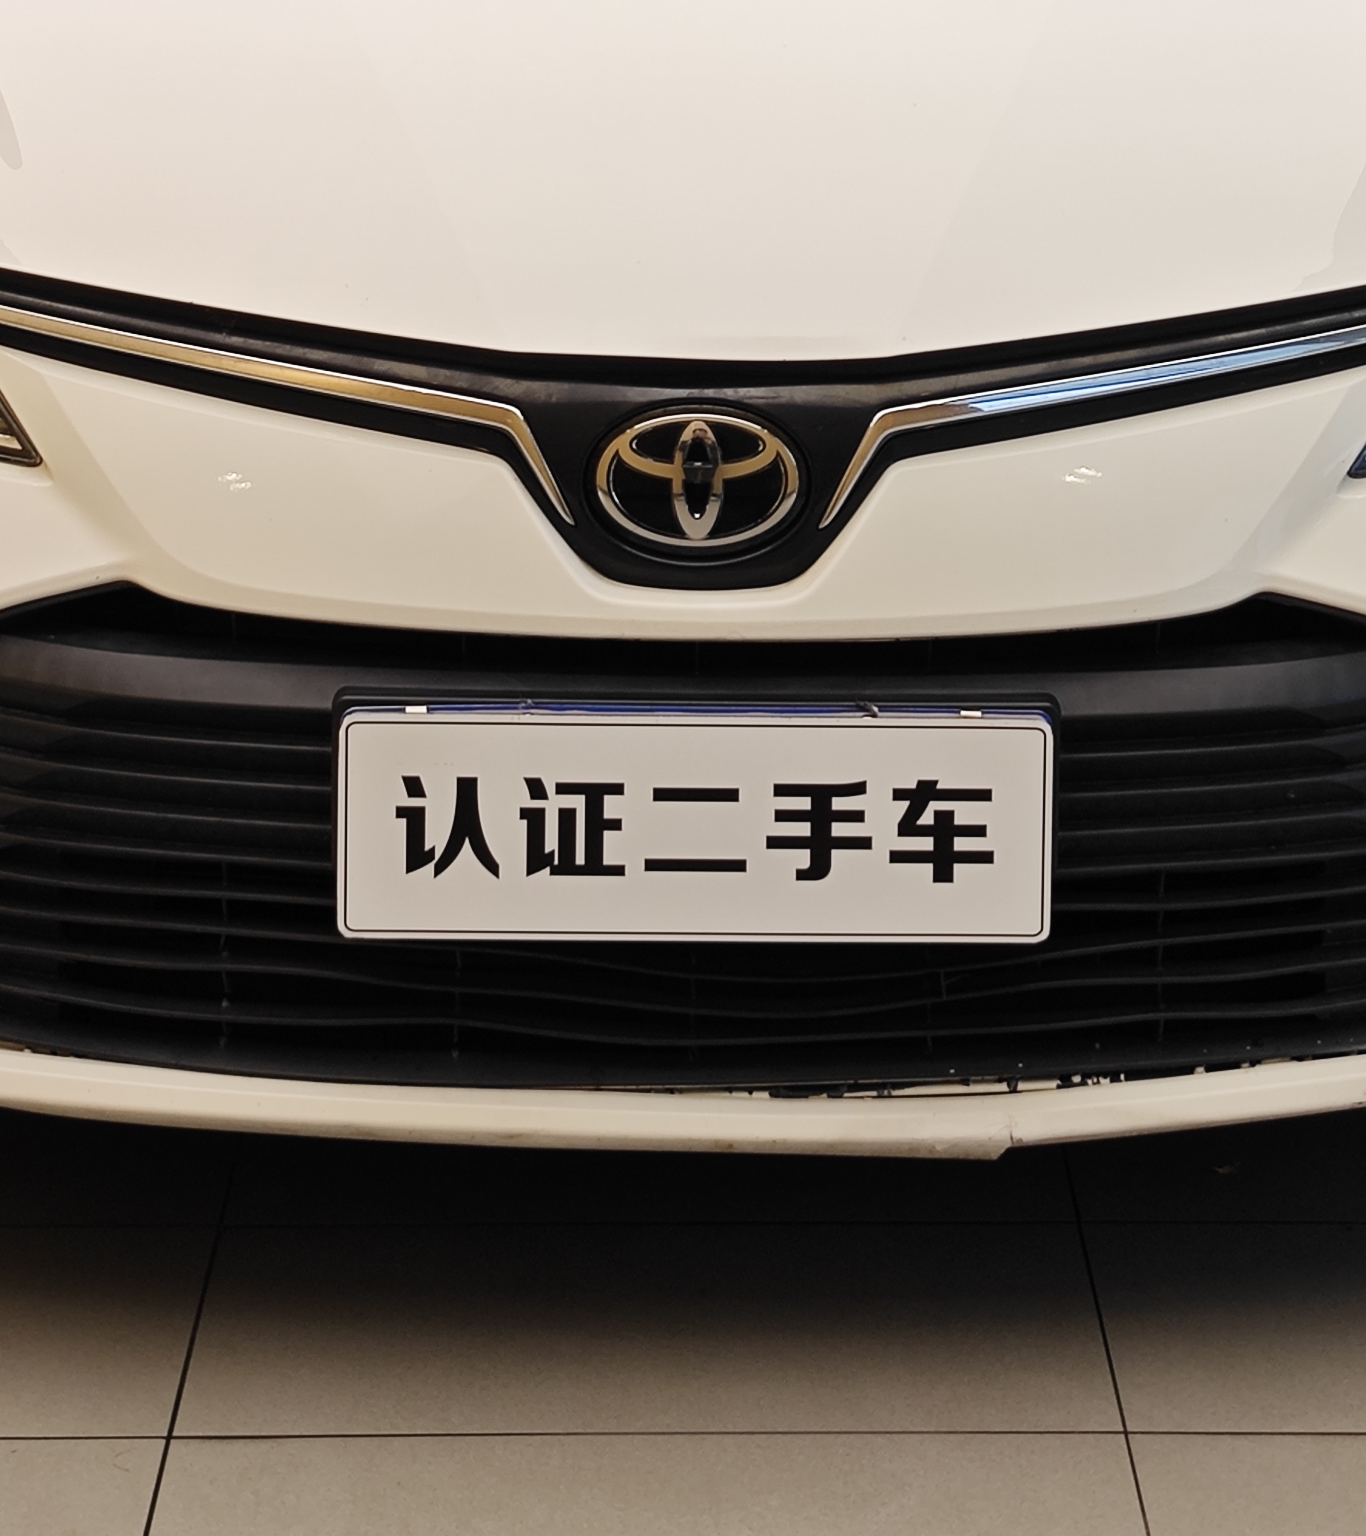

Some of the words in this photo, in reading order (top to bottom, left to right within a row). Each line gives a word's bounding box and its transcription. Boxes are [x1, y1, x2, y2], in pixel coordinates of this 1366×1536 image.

[394, 775, 996, 884] 认证二手车
